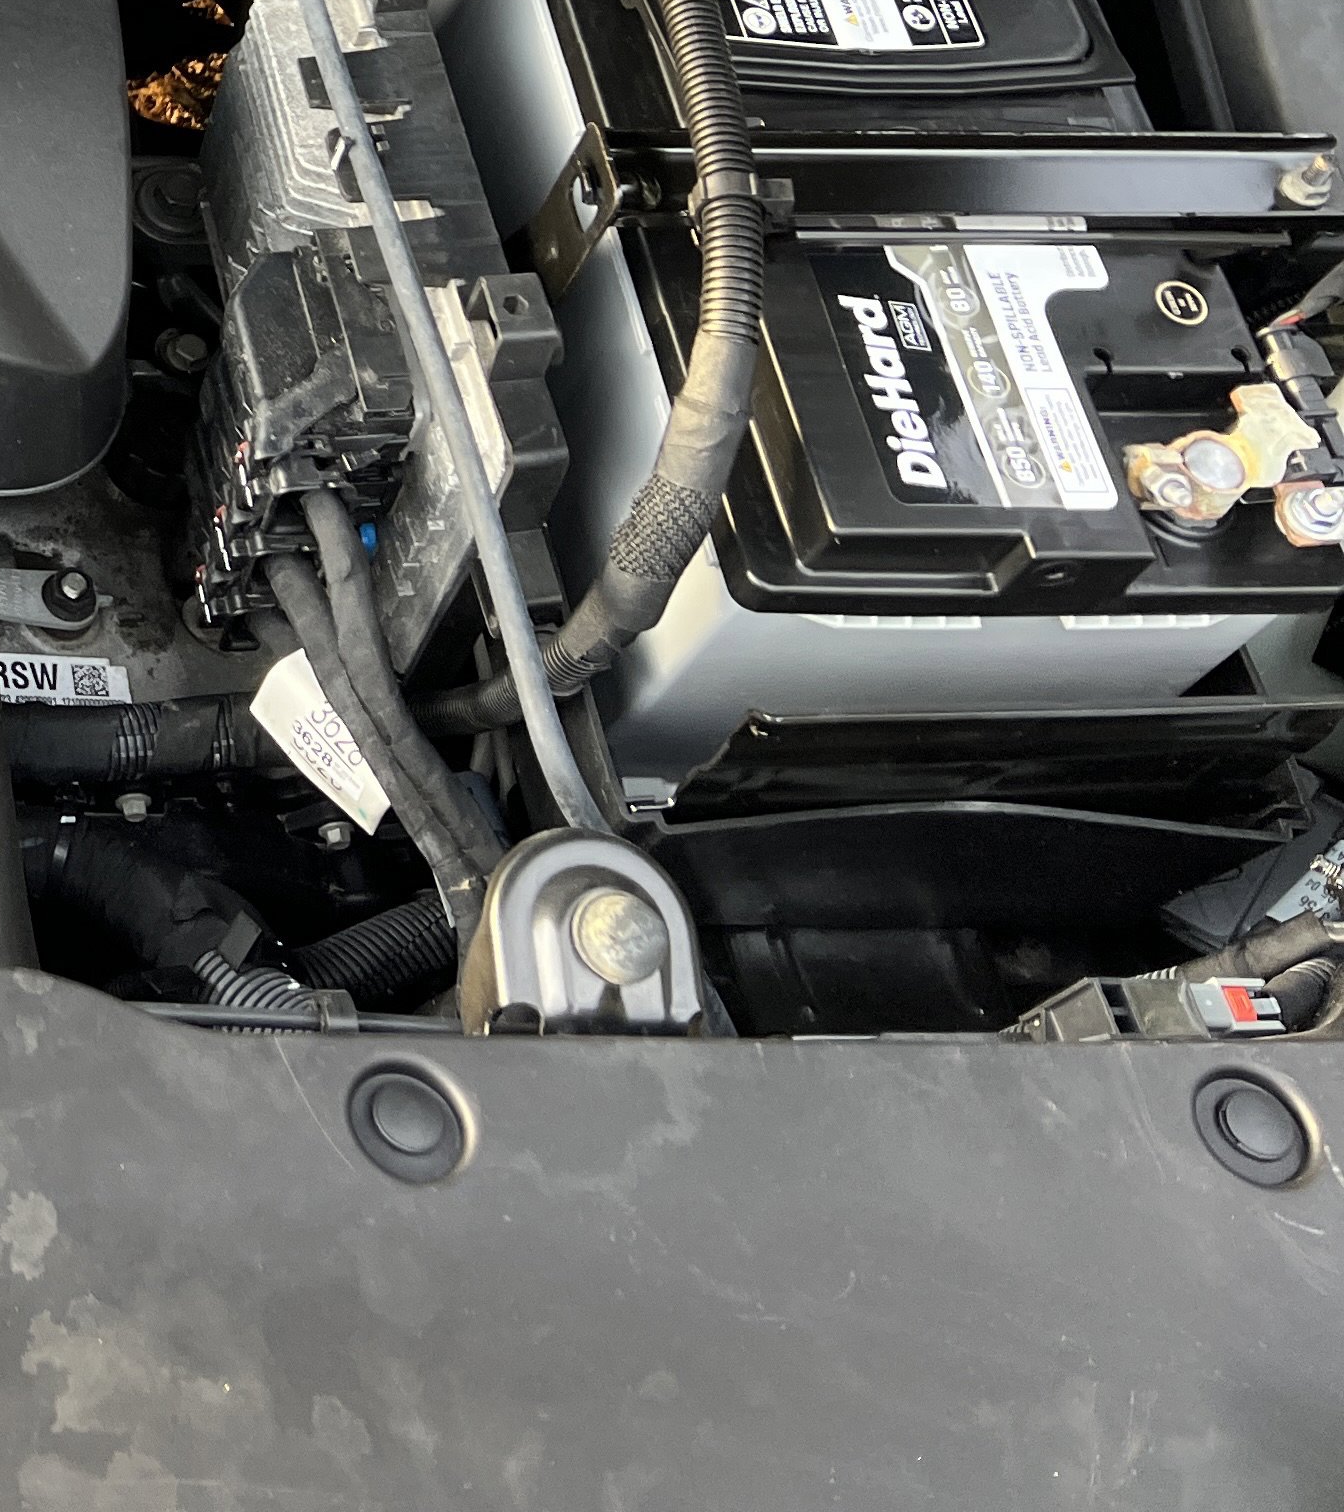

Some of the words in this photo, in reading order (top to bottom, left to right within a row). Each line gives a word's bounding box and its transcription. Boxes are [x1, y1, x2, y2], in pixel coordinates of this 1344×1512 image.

[946, 287, 971, 313] 80
[1004, 272, 1030, 315] Battery
[893, 303, 919, 348] AGM
[988, 271, 1034, 372] NON-SPILLABLE
[1020, 318, 1040, 342] Acid
[973, 361, 1002, 394] 140
[1031, 344, 1053, 373] Lead
[837, 294, 948, 488] DieHard
[1005, 446, 1036, 482] 850
[291, 719, 333, 767] 3628
